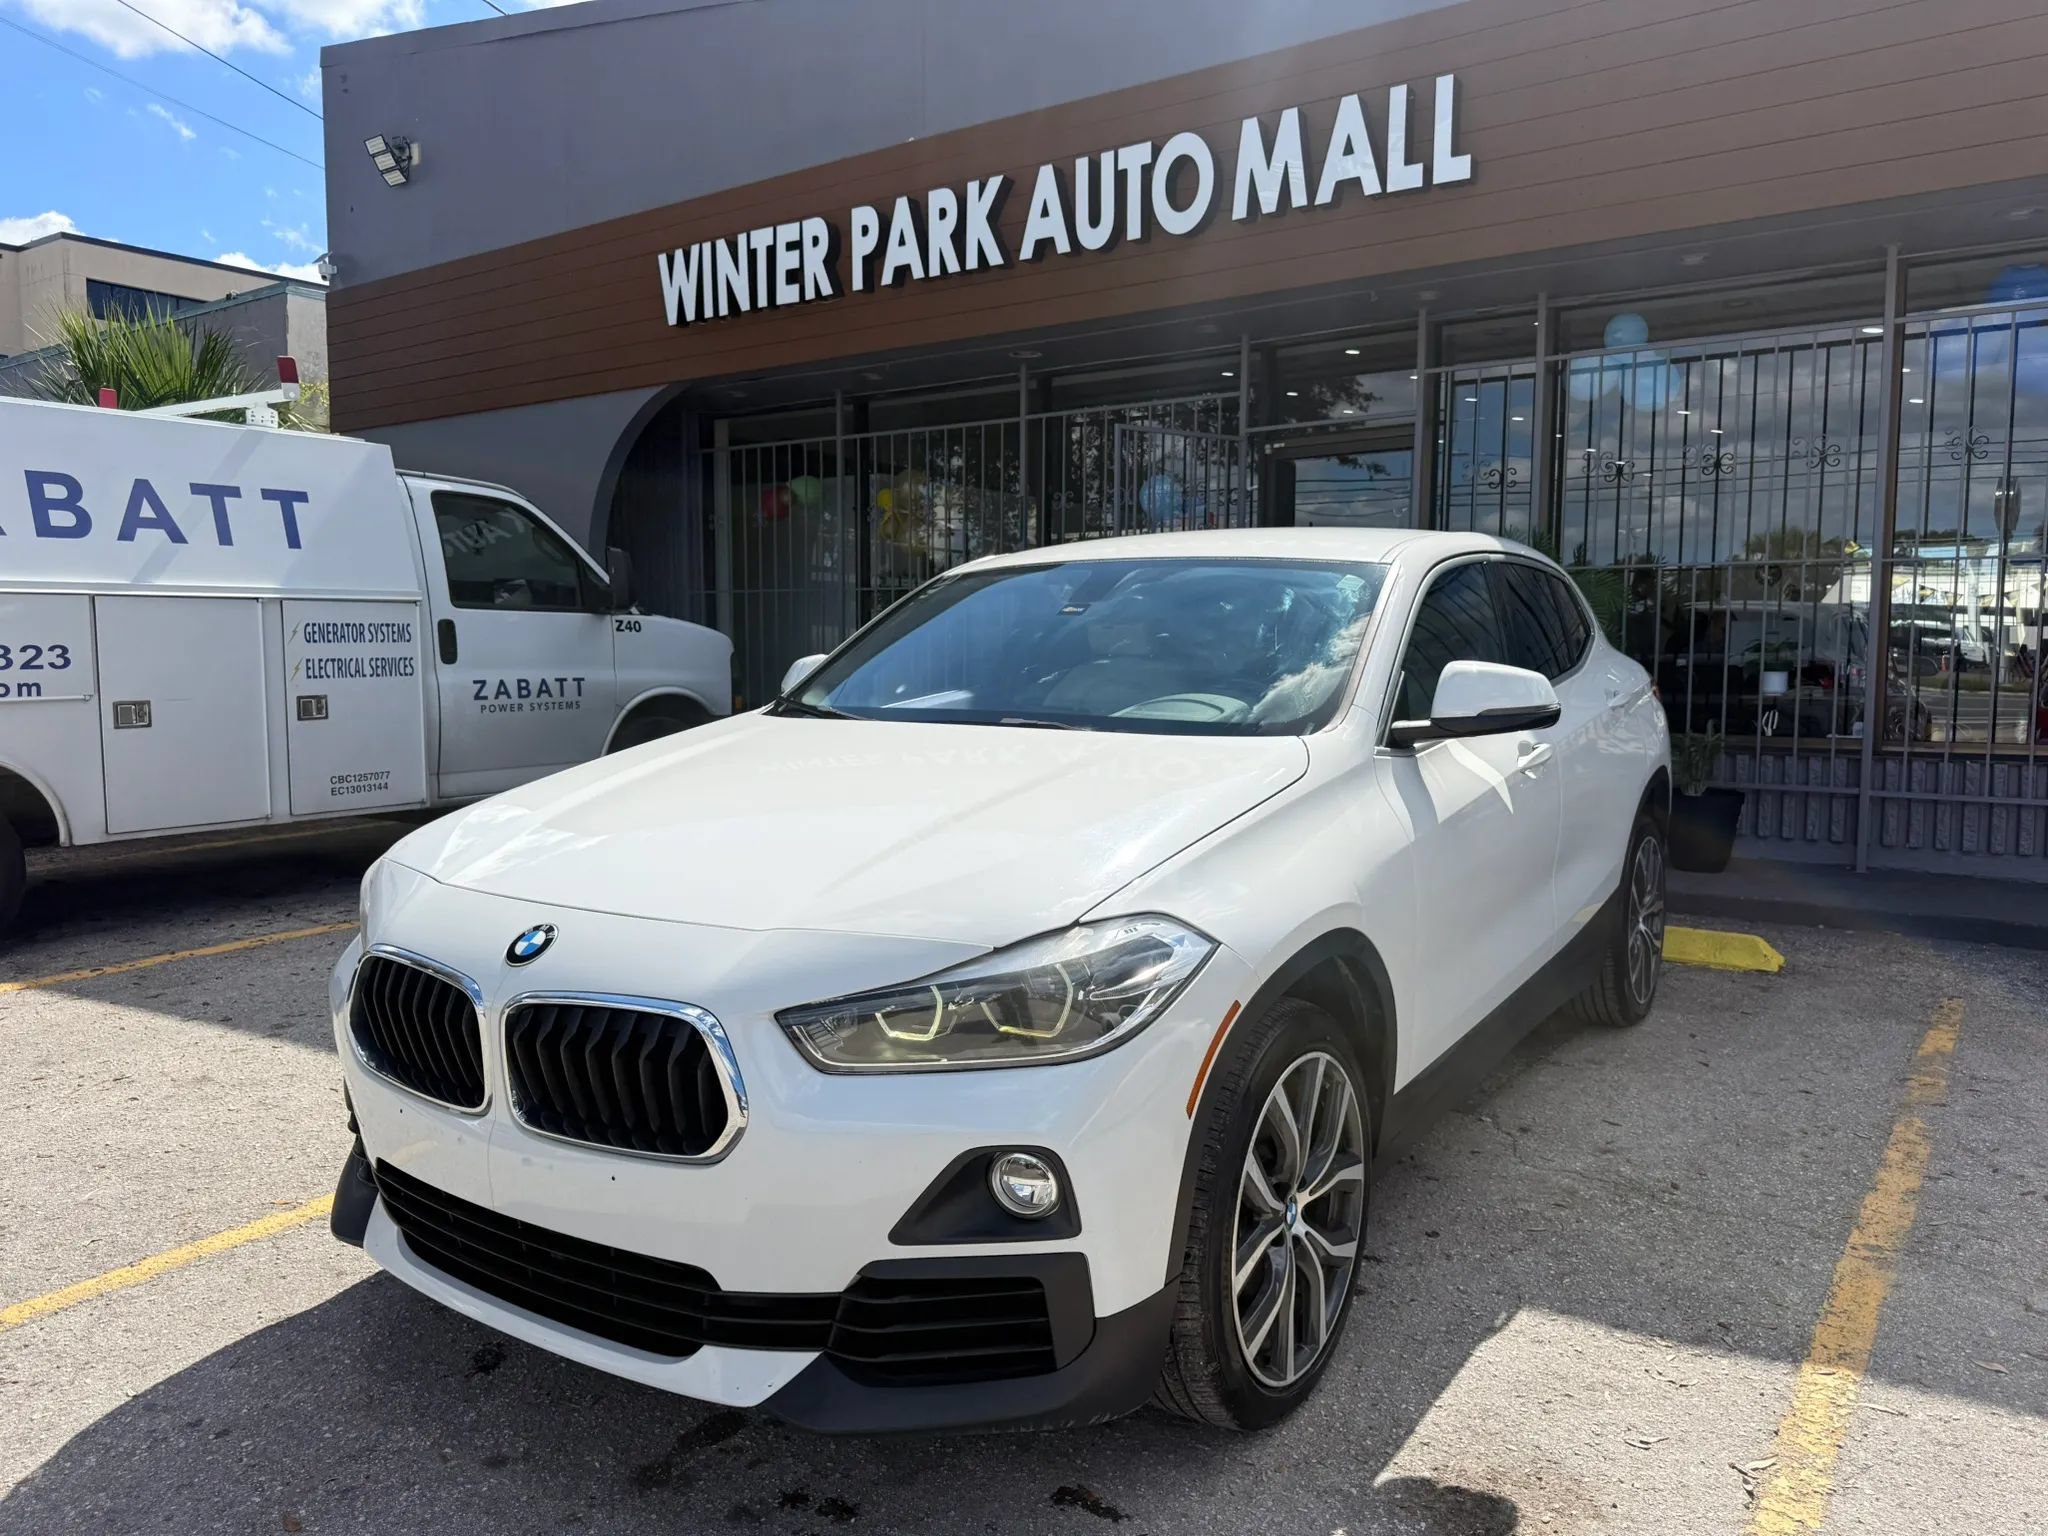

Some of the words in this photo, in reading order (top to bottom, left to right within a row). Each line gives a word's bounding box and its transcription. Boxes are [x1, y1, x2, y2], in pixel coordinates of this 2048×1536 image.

[658, 217, 834, 327] WINTER
[851, 175, 1005, 293] PARK
[1019, 132, 1216, 262] AUTO
[1231, 73, 1473, 222] MALL
[0, 469, 310, 550] BATT
[304, 622, 366, 644] GENERATOR
[368, 622, 412, 643] SYSTEMS
[615, 619, 642, 633] Z40
[305, 657, 367, 679] ELECTRICAL
[369, 656, 415, 678] SERVICES
[472, 677, 586, 701] ZABATT
[480, 703, 524, 714] POWER
[529, 701, 581, 711] SYSTEMS
[330, 770, 391, 785] CBC1257077
[330, 782, 389, 797] EC13013144
